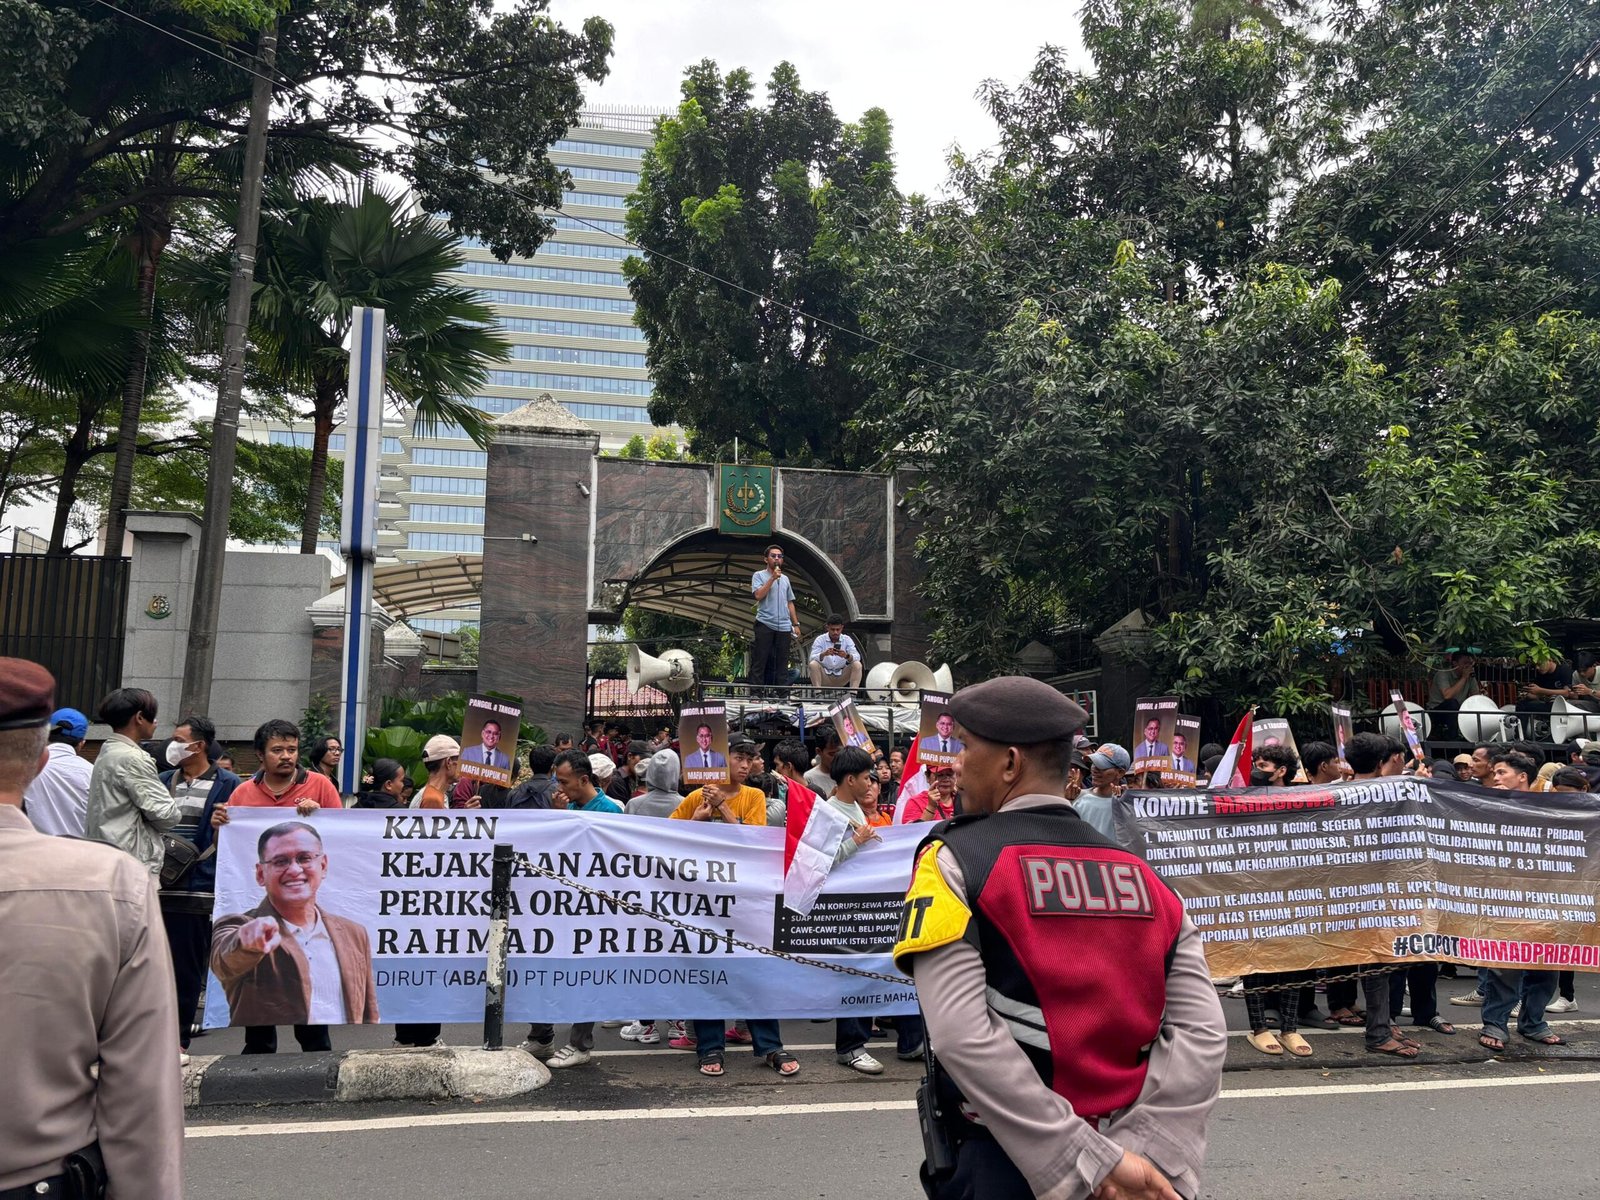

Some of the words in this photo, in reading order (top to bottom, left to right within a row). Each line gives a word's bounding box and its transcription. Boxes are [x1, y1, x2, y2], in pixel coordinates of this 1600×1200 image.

[469, 699, 492, 710] PANGGIL
[493, 704, 498, 712] &
[498, 704, 521, 717] TANGKAP
[1181, 719, 1200, 728] TANGKAP
[921, 752, 938, 762] MAFIA
[461, 764, 480, 775] MAFIA
[481, 768, 501, 780] PUPUK
[1133, 795, 1208, 818] KOMITE
[1339, 781, 1432, 806] INDONESIA
[382, 816, 498, 840] KAPAN
[1143, 831, 1153, 844] 1.
[1157, 828, 1211, 843] MENUNTUT
[1216, 824, 1277, 839] KEJAKSAAN
[1282, 821, 1317, 835] AGUNG
[1322, 818, 1361, 832] SEGERA
[1426, 816, 1445, 830] DAN
[1450, 820, 1496, 835] MENAHAN
[1500, 825, 1543, 838] RAHMAT
[1146, 847, 1196, 861] DIREKTUR
[1198, 843, 1235, 858] UTAMA
[1238, 842, 1250, 854] PT
[1253, 839, 1288, 853] PUPUK
[1290, 836, 1350, 851] INDONESIA,
[1353, 834, 1378, 847] ATAS
[1381, 831, 1425, 845] DUGAAN
[1506, 840, 1541, 854] DALAM
[1544, 844, 1588, 858] SKANDAL
[381, 852, 581, 878] KEJAKAAN
[586, 853, 699, 882] AGUNG
[706, 861, 737, 882] RI
[1206, 860, 1232, 874] YANG
[1235, 854, 1323, 871] MENGAKIBATKAN
[1327, 850, 1368, 865] POTENSI
[1370, 848, 1423, 862] KERUGIAN
[1454, 852, 1496, 868] SEBESAR
[1499, 857, 1515, 869] RP.
[1517, 857, 1534, 871] 8,3
[1026, 860, 1151, 913] POLISI
[1184, 895, 1221, 910] NUNTUT
[1329, 882, 1383, 899] KEPOLISIAN
[1407, 880, 1432, 894] KPK
[1464, 886, 1522, 902] MELAKUKAN
[1526, 890, 1595, 907] PENYELIDIKAN
[530, 889, 643, 917] ORANG
[650, 891, 736, 917] KUAT
[828, 902, 860, 910] KORUPSI
[1218, 911, 1245, 925] ATAS
[1248, 907, 1291, 922] TEMUAN
[1295, 905, 1324, 919] AUDIT
[1327, 900, 1386, 915] INDEPENDEN
[1390, 898, 1423, 911] YANG
[1481, 905, 1559, 921] PENYIMPANGAN
[1562, 910, 1596, 923] SERIUS
[813, 914, 851, 922] MENYUAP
[853, 913, 873, 921] SEWA
[875, 912, 898, 920] KAPAL
[377, 929, 554, 955] RAHMAD
[572, 928, 735, 955] PRIBADI
[790, 926, 837, 934] CAWE-CAWE
[838, 925, 857, 934] JUAL
[858, 925, 874, 933] BELI
[820, 938, 848, 946] UNTUK
[849, 937, 868, 945] ISTRI
[1200, 928, 1249, 943] APORAAN
[1252, 924, 1307, 939] KEUANGAN
[1310, 922, 1322, 934] PT
[1325, 919, 1355, 933] PUPUK
[376, 970, 437, 987] DIRUT
[443, 969, 518, 988] (ABAI)
[525, 970, 548, 987] PT
[553, 969, 617, 987] PUPUK
[623, 968, 729, 986] INDONESIA
[841, 995, 881, 1005] KOMITE
